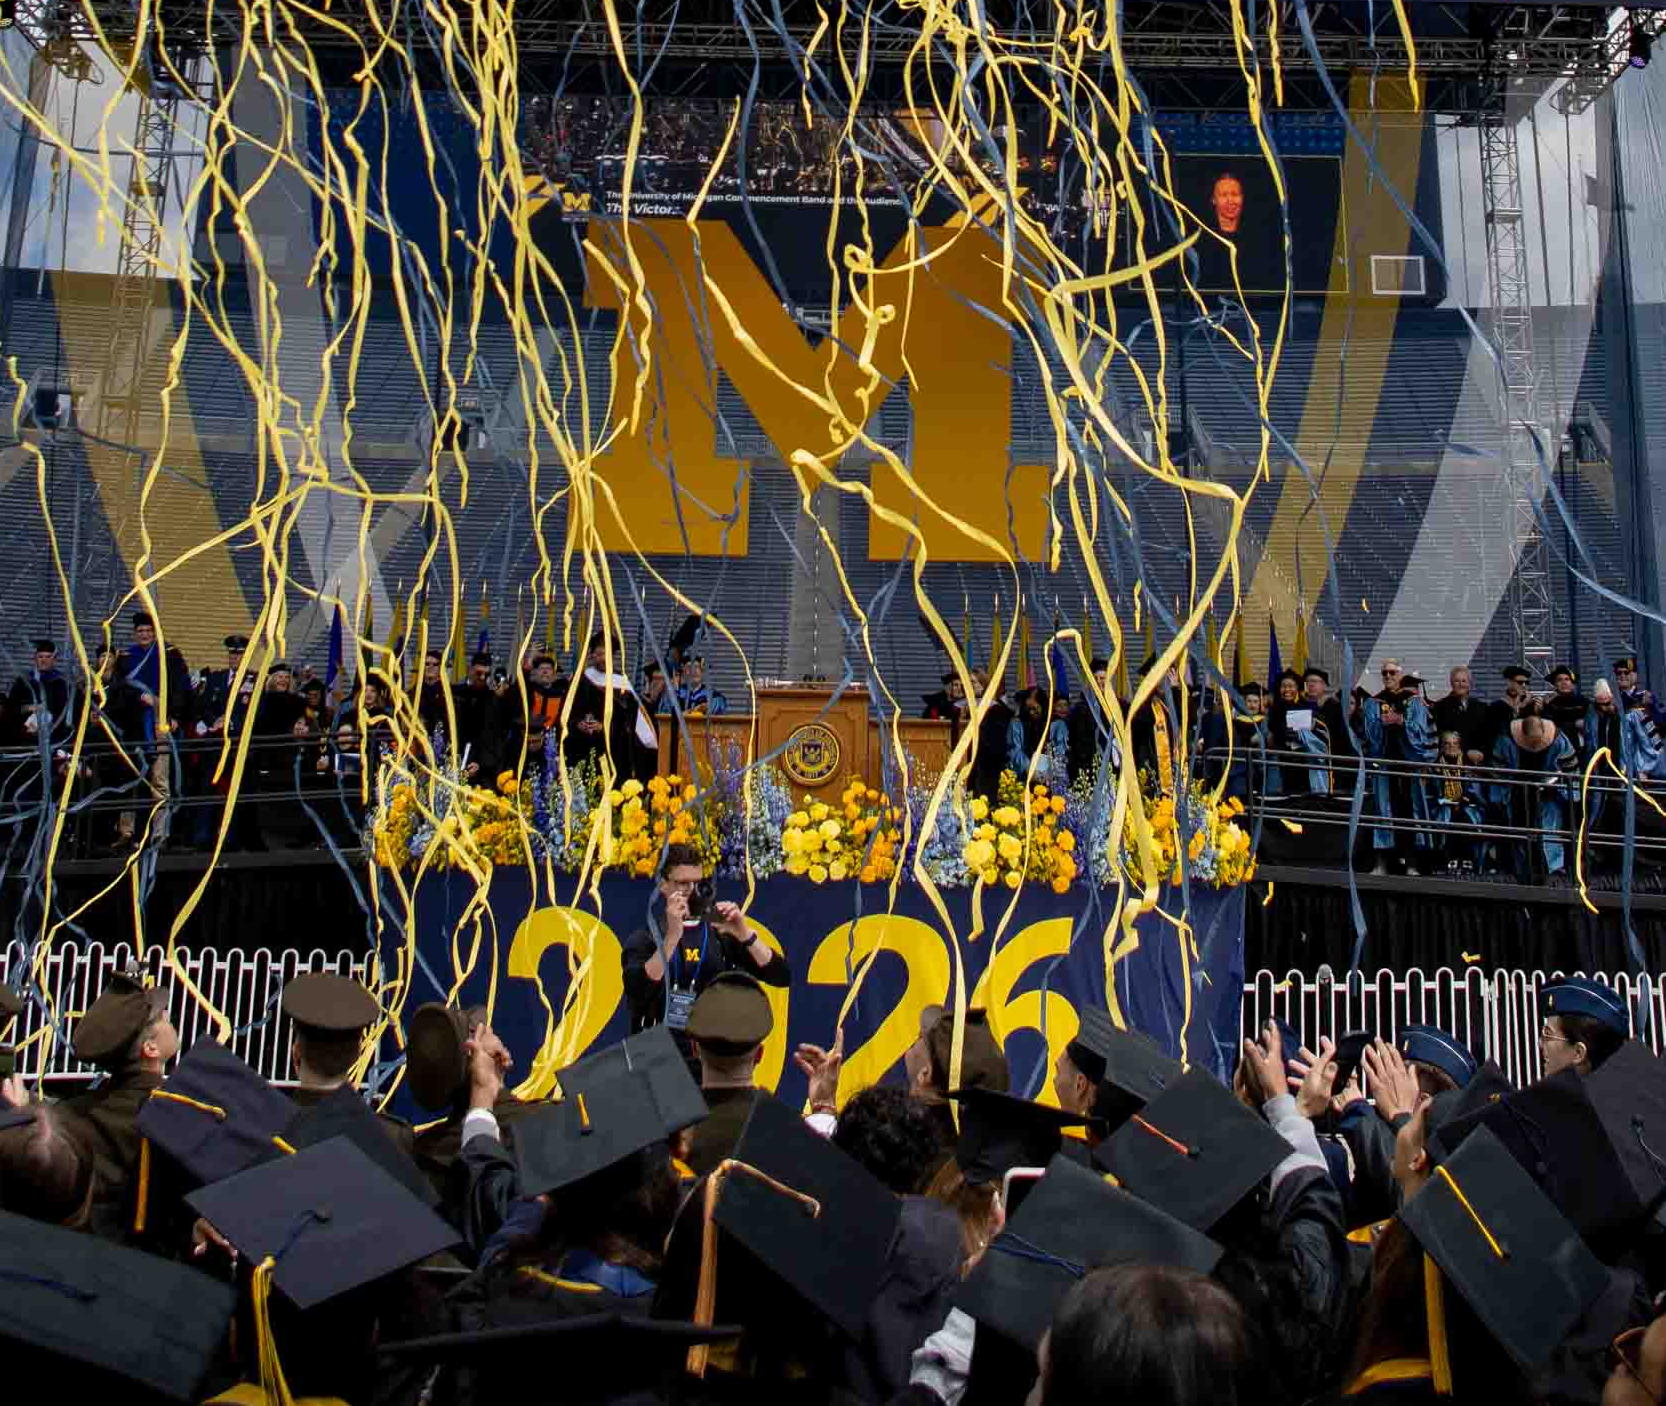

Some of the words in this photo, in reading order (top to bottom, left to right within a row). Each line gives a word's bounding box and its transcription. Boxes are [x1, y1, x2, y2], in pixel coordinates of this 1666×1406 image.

[625, 193, 670, 202] niversity
[683, 193, 723, 203] Micgan
[802, 196, 827, 204] Band
[864, 197, 904, 206] Audienc
[606, 202, 630, 213] Th
[571, 218, 1053, 562] M
[685, 948, 700, 962] M
[508, 905, 1089, 1140] 226
